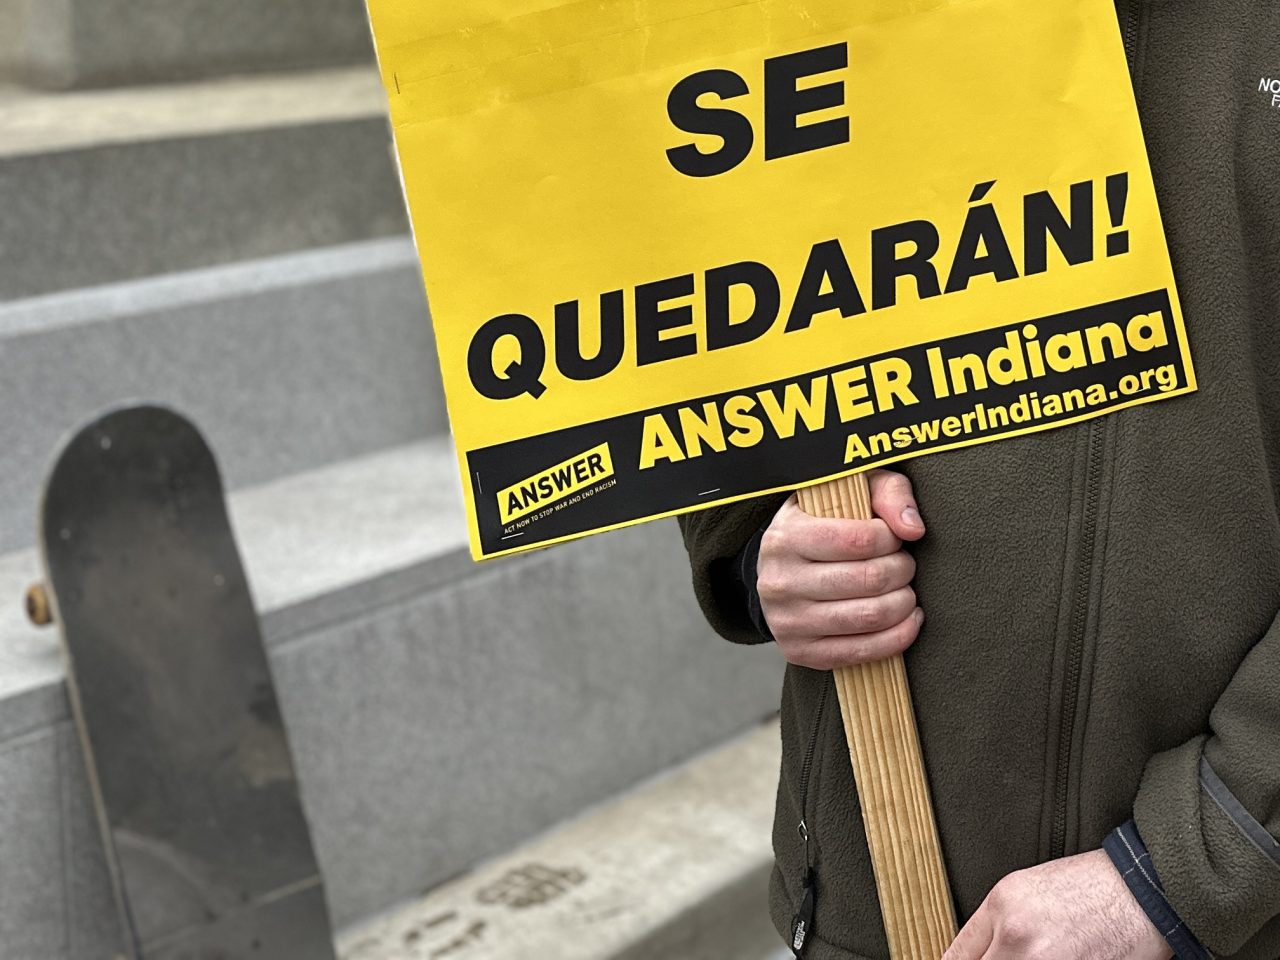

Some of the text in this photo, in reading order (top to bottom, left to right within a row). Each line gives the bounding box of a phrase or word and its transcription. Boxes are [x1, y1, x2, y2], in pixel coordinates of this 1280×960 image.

[665, 41, 850, 178] SE
[467, 171, 1129, 401] QUEDARÁN!
[638, 310, 1169, 470] ANSWER Indiana
[843, 363, 1178, 464] AnswerIndiana.org
[504, 525, 515, 535] ACT
[516, 518, 530, 529] NOW
[539, 507, 554, 519] STOP
[554, 501, 568, 512] WAR
[568, 495, 581, 505] AND
[581, 489, 594, 499] END
[594, 479, 617, 493] RACISM
[506, 452, 606, 516] ANSWER
